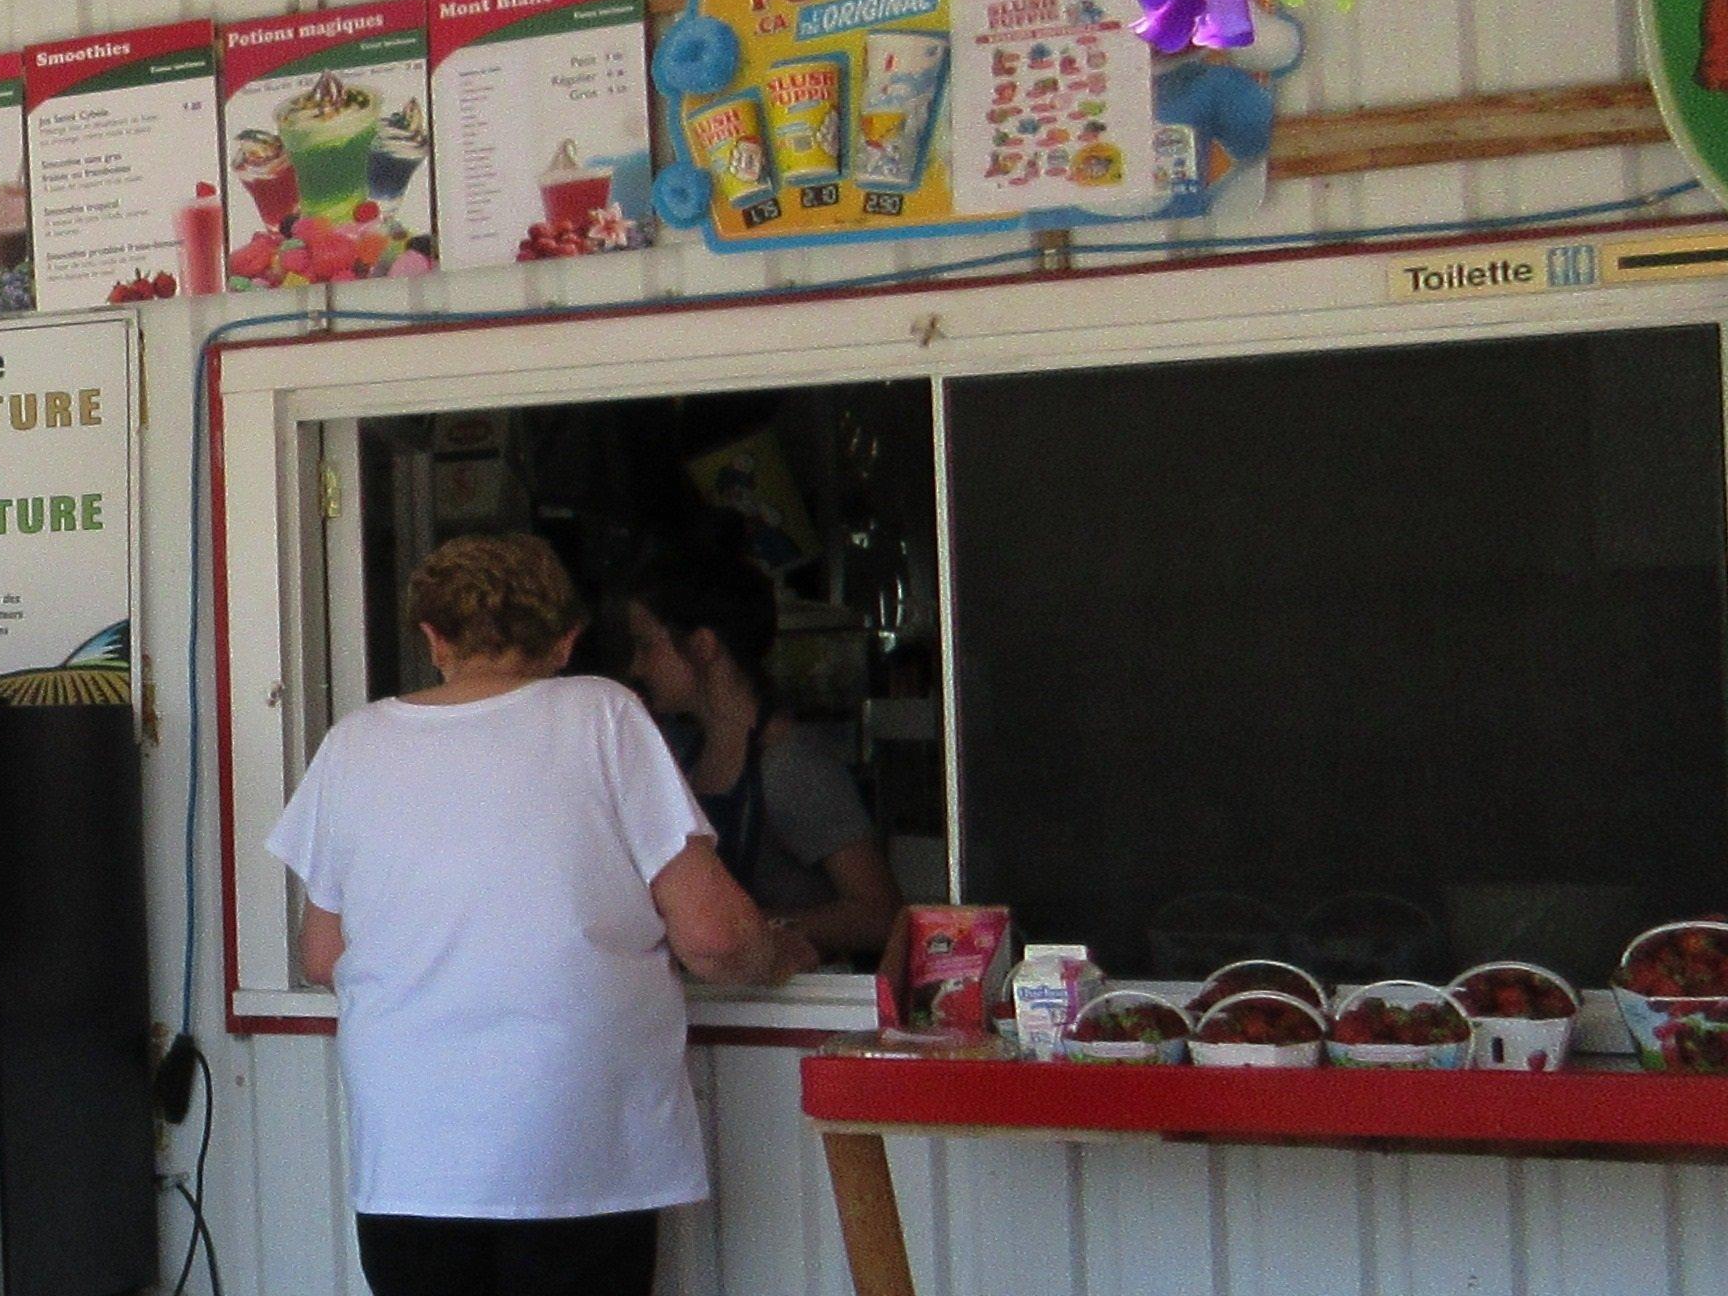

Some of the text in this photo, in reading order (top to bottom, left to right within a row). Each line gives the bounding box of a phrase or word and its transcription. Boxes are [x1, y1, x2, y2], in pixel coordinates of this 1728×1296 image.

[439, 0, 490, 19] Mont
[227, 13, 384, 48] Potions magiques
[36, 42, 130, 67] Smoothies
[1404, 260, 1534, 292] Toilette
[1, 592, 21, 605] des
